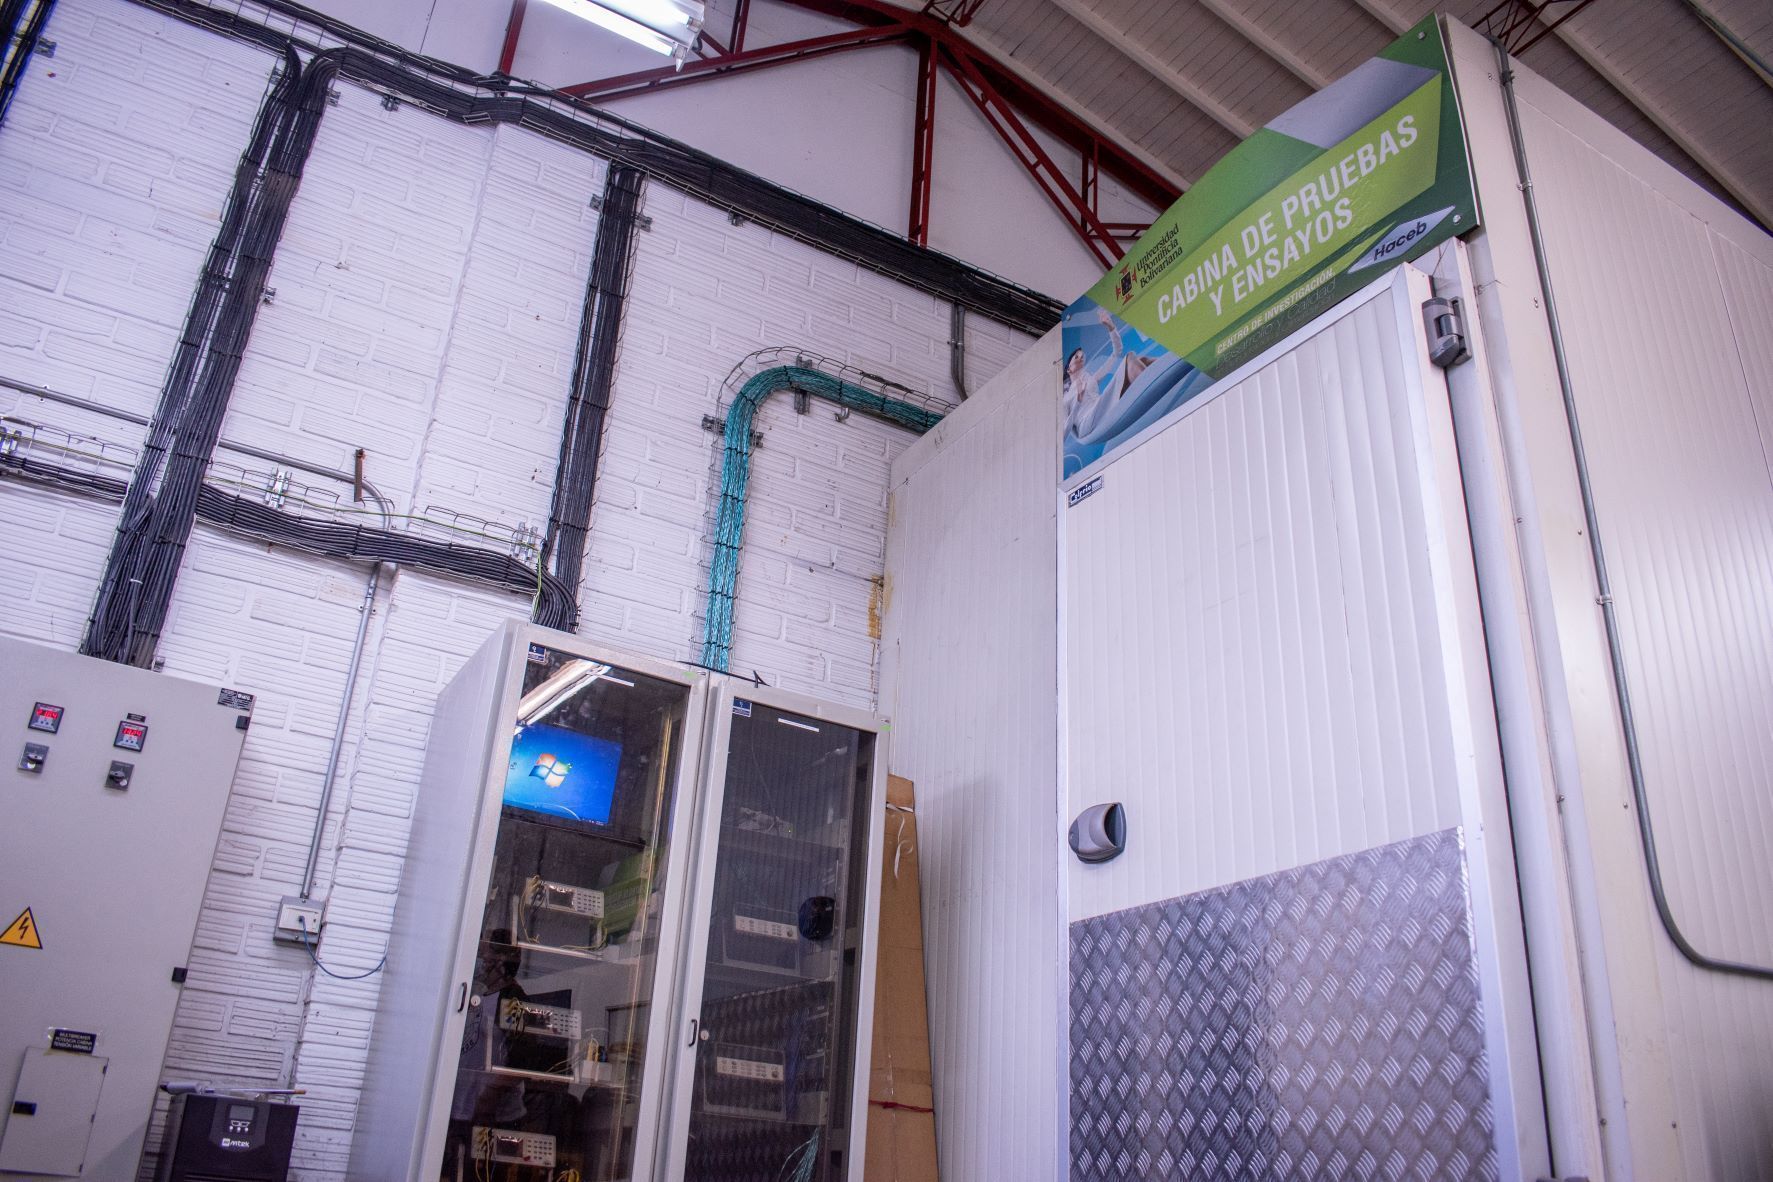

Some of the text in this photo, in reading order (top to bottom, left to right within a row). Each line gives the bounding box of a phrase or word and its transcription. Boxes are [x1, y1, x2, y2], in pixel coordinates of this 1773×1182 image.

[1157, 114, 1419, 325] CABINA DE PRUEBAS
[1136, 222, 1179, 271] Universidad
[1143, 239, 1179, 274] Pontificia
[1208, 197, 1354, 317] Y ENSAYOS
[1373, 221, 1428, 261] Haceb
[1140, 246, 1183, 288] Bolivariana
[1217, 326, 1250, 355] CENTRO
[1252, 315, 1263, 330] DE
